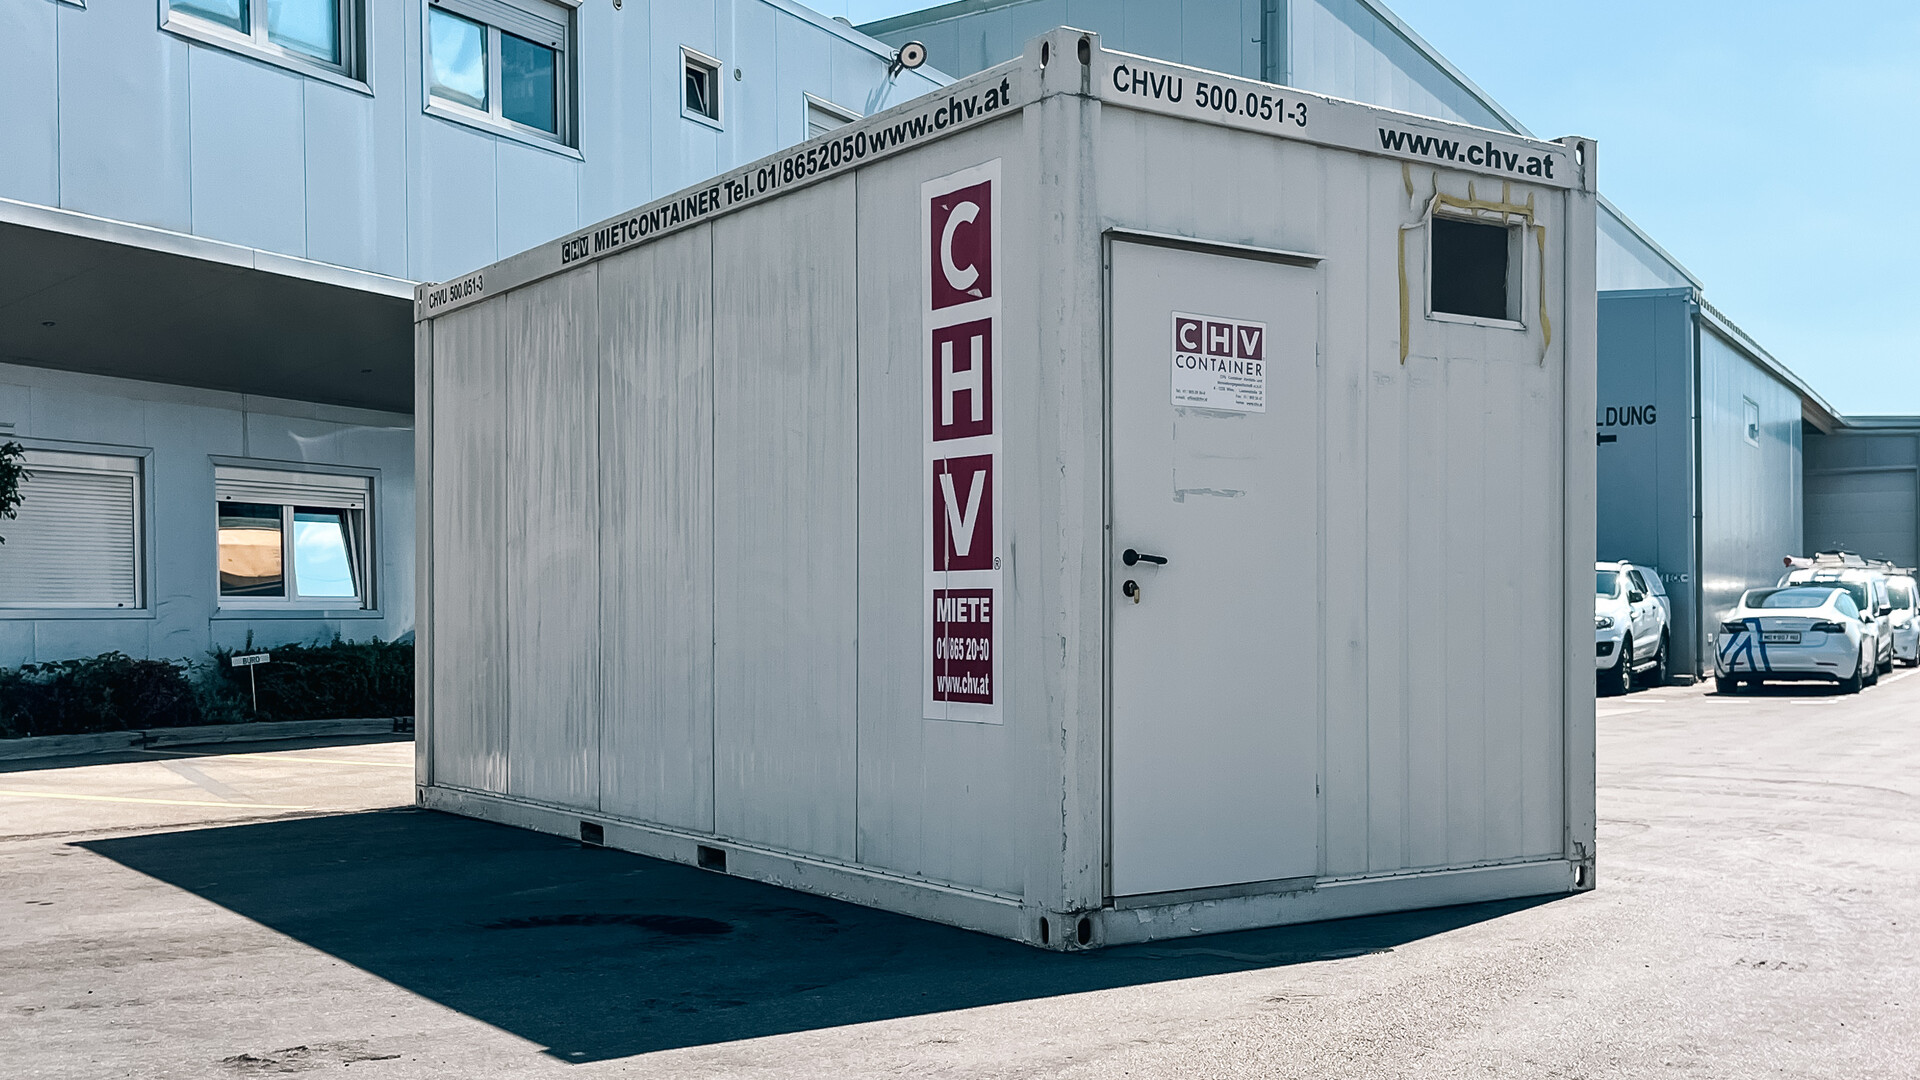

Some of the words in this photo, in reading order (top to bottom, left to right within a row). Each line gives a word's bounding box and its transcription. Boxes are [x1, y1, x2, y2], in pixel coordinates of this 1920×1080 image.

[1112, 64, 1183, 103] CHVU
[1195, 82, 1308, 128] 500.051-3
[1378, 127, 1554, 179] www.chv.at
[562, 236, 589, 265] CHV
[594, 187, 720, 253] MIETCONTAINER
[724, 178, 754, 204] Tel.
[756, 131, 867, 194] 01/8652050
[869, 77, 1010, 154] www.chv.at
[429, 287, 448, 309] CHVU
[450, 274, 484, 302] 500.051-3
[1178, 321, 1261, 357] CHV
[1175, 354, 1262, 377] CONTAINER
[936, 597, 990, 623] MIETE
[936, 670, 990, 696] www.chv.at
